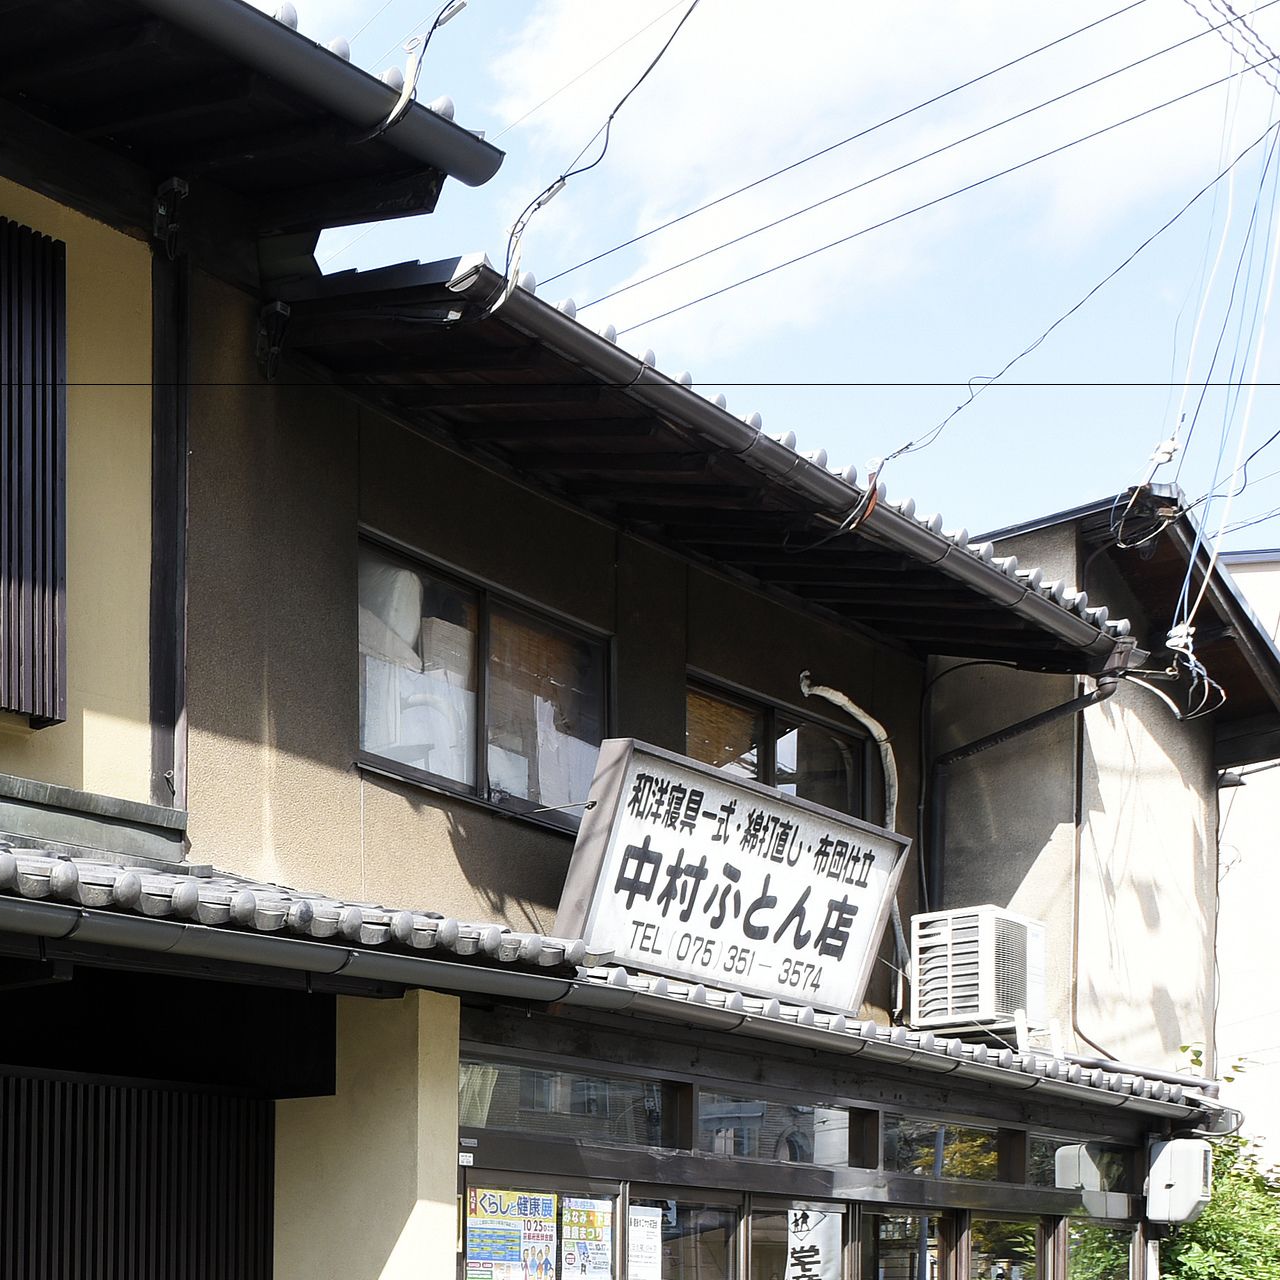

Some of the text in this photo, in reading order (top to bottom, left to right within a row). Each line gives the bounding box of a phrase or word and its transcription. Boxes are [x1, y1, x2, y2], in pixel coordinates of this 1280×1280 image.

[614, 835, 859, 962] 中村ふとん店
[631, 920, 662, 955] TEL
[479, 1193, 553, 1217] くらしと健康展
